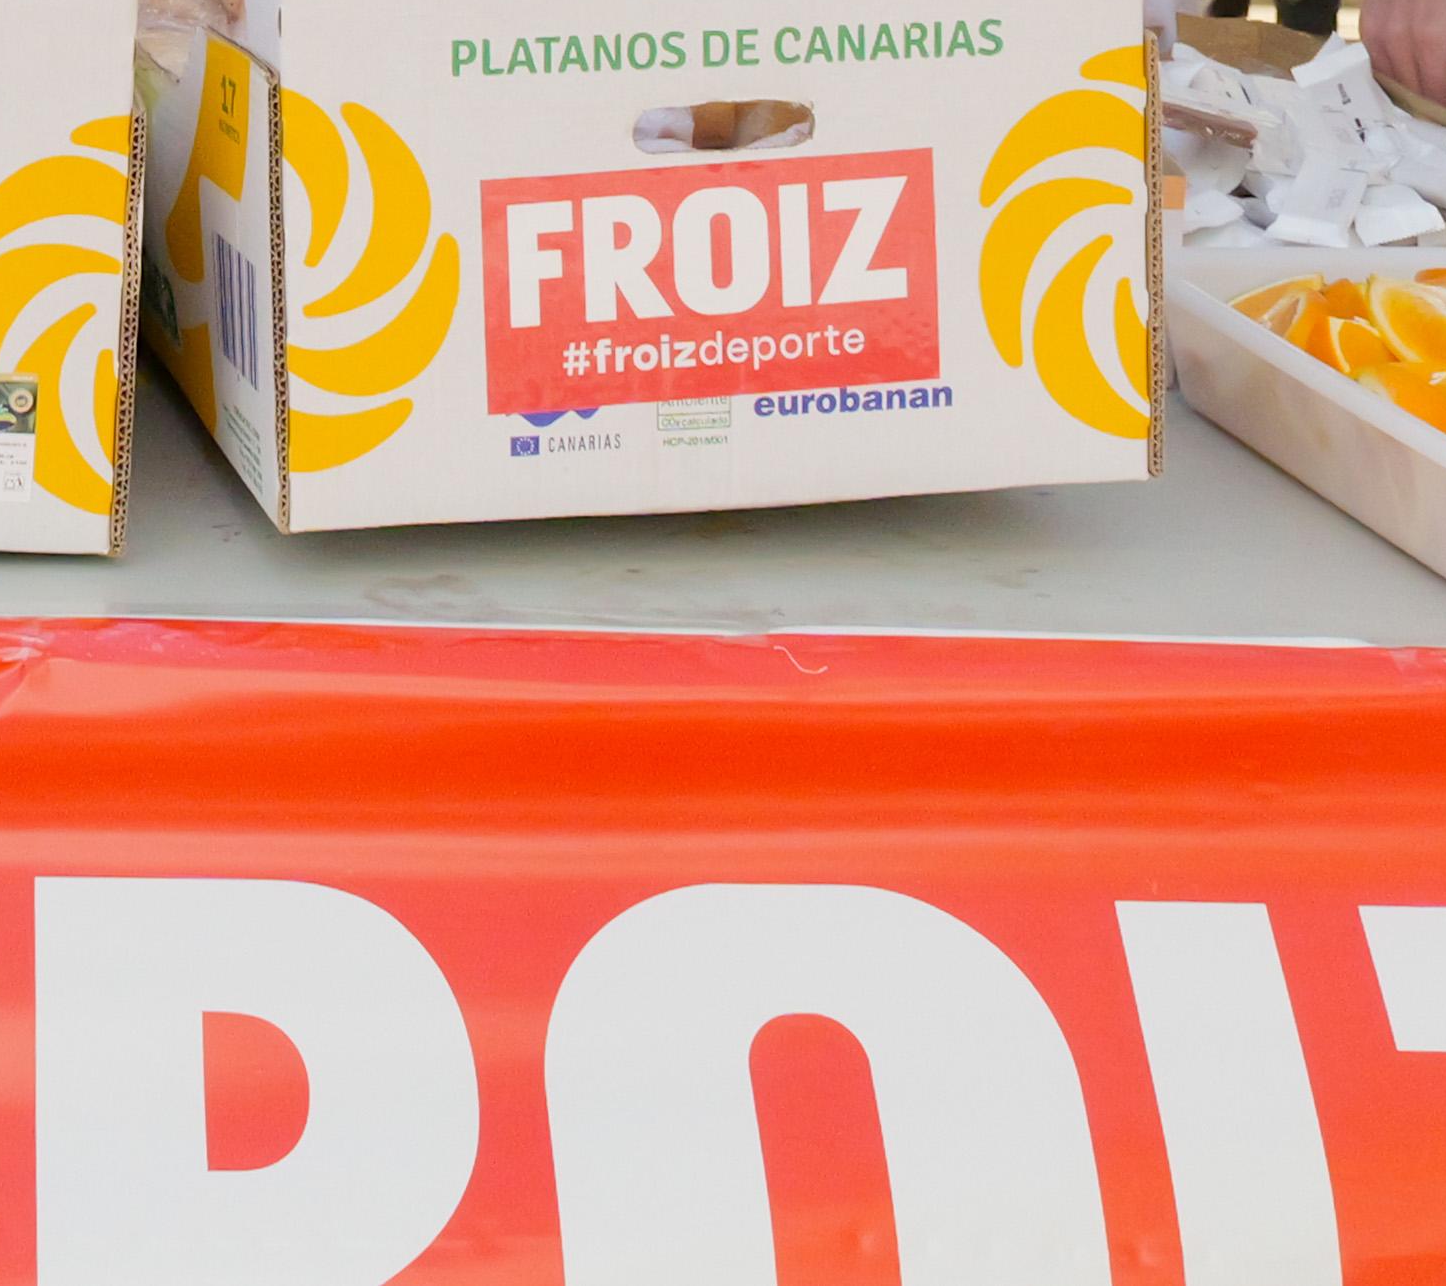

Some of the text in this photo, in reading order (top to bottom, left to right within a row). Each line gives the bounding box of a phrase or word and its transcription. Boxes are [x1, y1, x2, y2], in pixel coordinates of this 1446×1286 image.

[450, 17, 1005, 78] PLATANOS DE CANARIAS
[508, 175, 908, 329] FROIZ
[562, 322, 866, 378] #froizdeporte
[753, 385, 954, 417] eurobanan
[547, 433, 622, 453] CANARIAS
